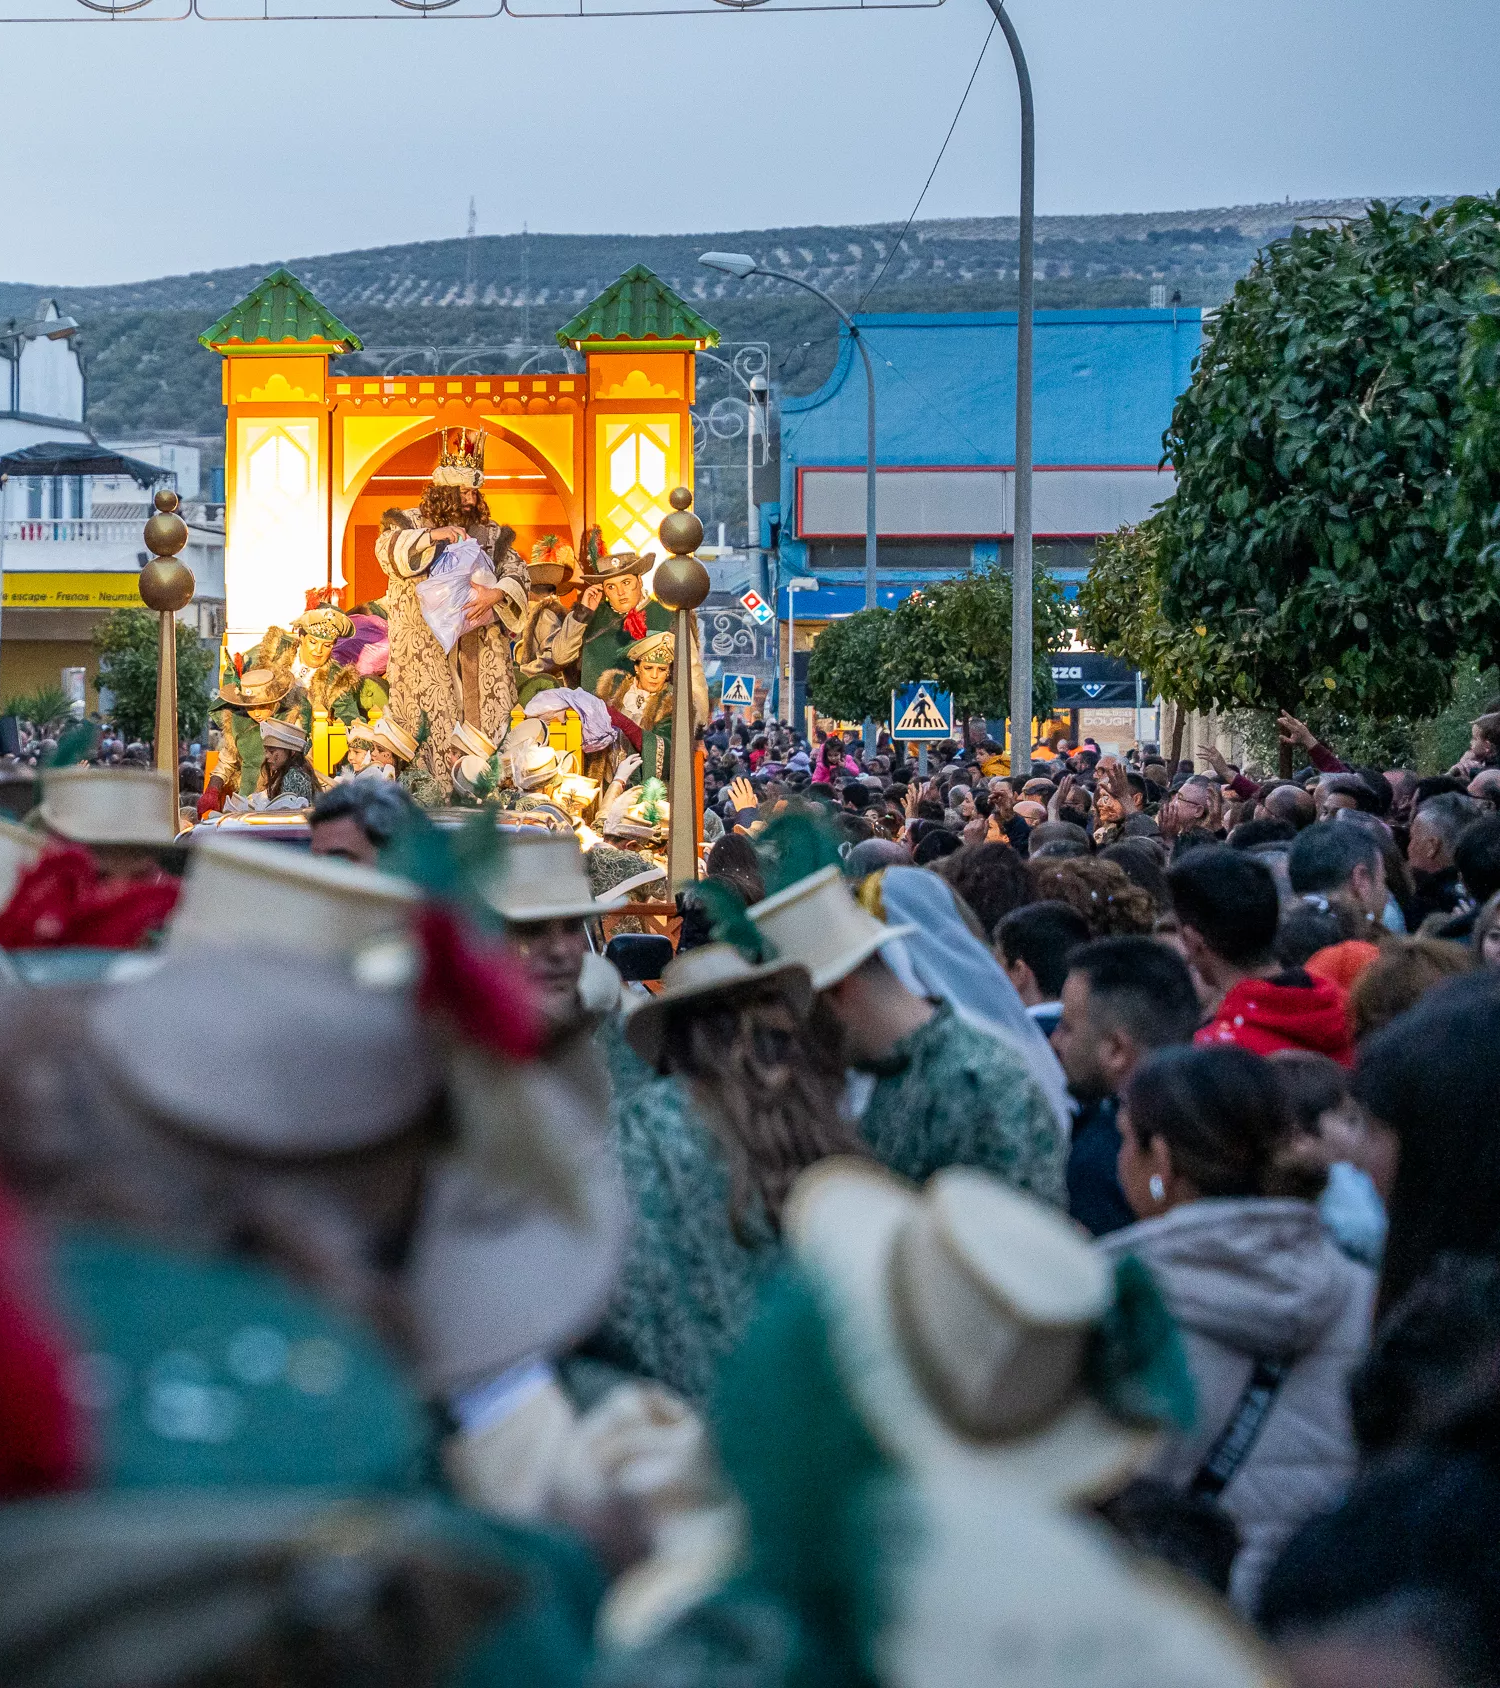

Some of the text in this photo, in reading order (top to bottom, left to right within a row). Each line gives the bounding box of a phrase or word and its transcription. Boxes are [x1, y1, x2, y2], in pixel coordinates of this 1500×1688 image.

[11, 593, 47, 603] escape
[55, 591, 89, 601] Frenos
[1052, 666, 1082, 679] zza
[1084, 717, 1132, 726] DOUGH
